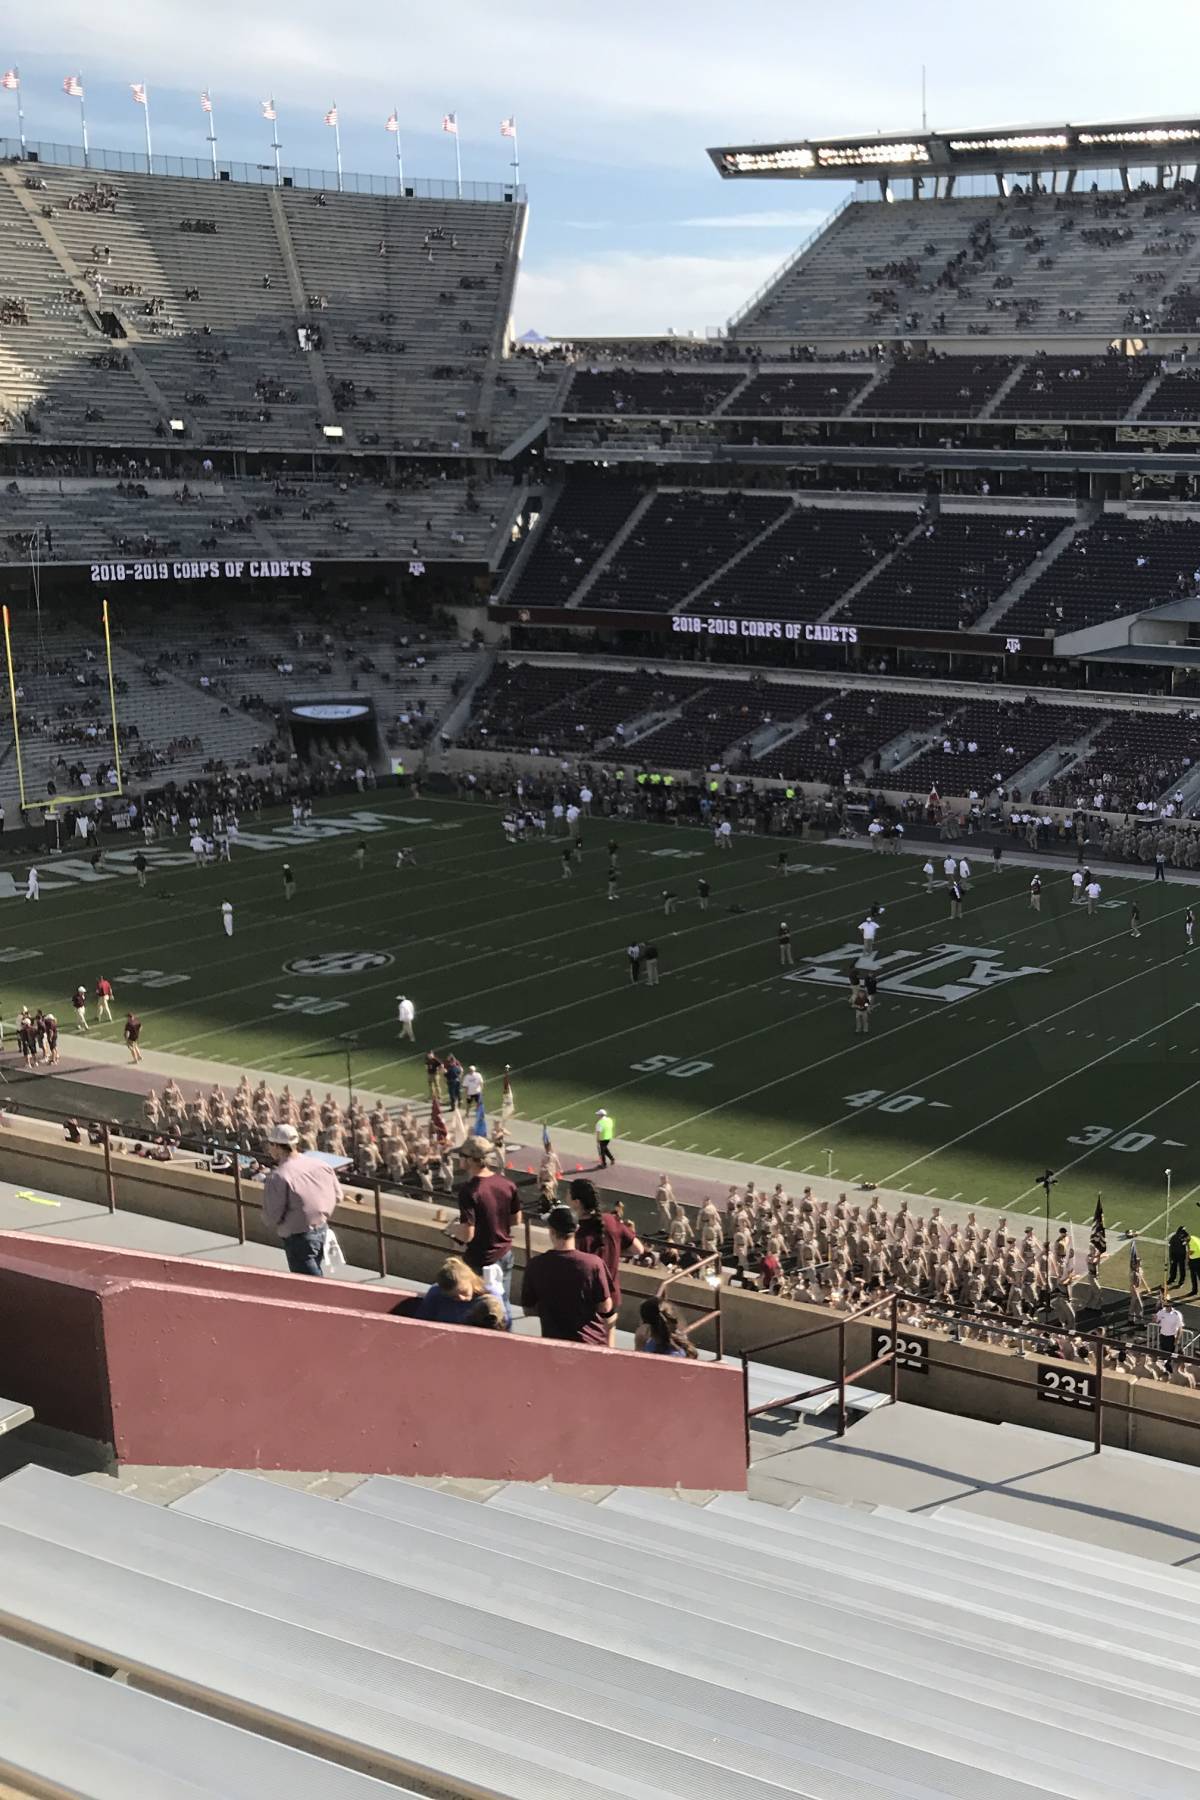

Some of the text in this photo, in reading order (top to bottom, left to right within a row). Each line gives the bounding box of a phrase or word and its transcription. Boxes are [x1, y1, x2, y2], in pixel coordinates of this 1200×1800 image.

[91, 561, 312, 581] 2018-2019 CORPS OF CADETS
[672, 617, 858, 642] 2018-2019 CORPS OF CADETS
[629, 1055, 715, 1078] 50
[842, 1088, 926, 1113] 40
[1066, 1125, 1158, 1153] 30
[1043, 1371, 1093, 1406] 231
